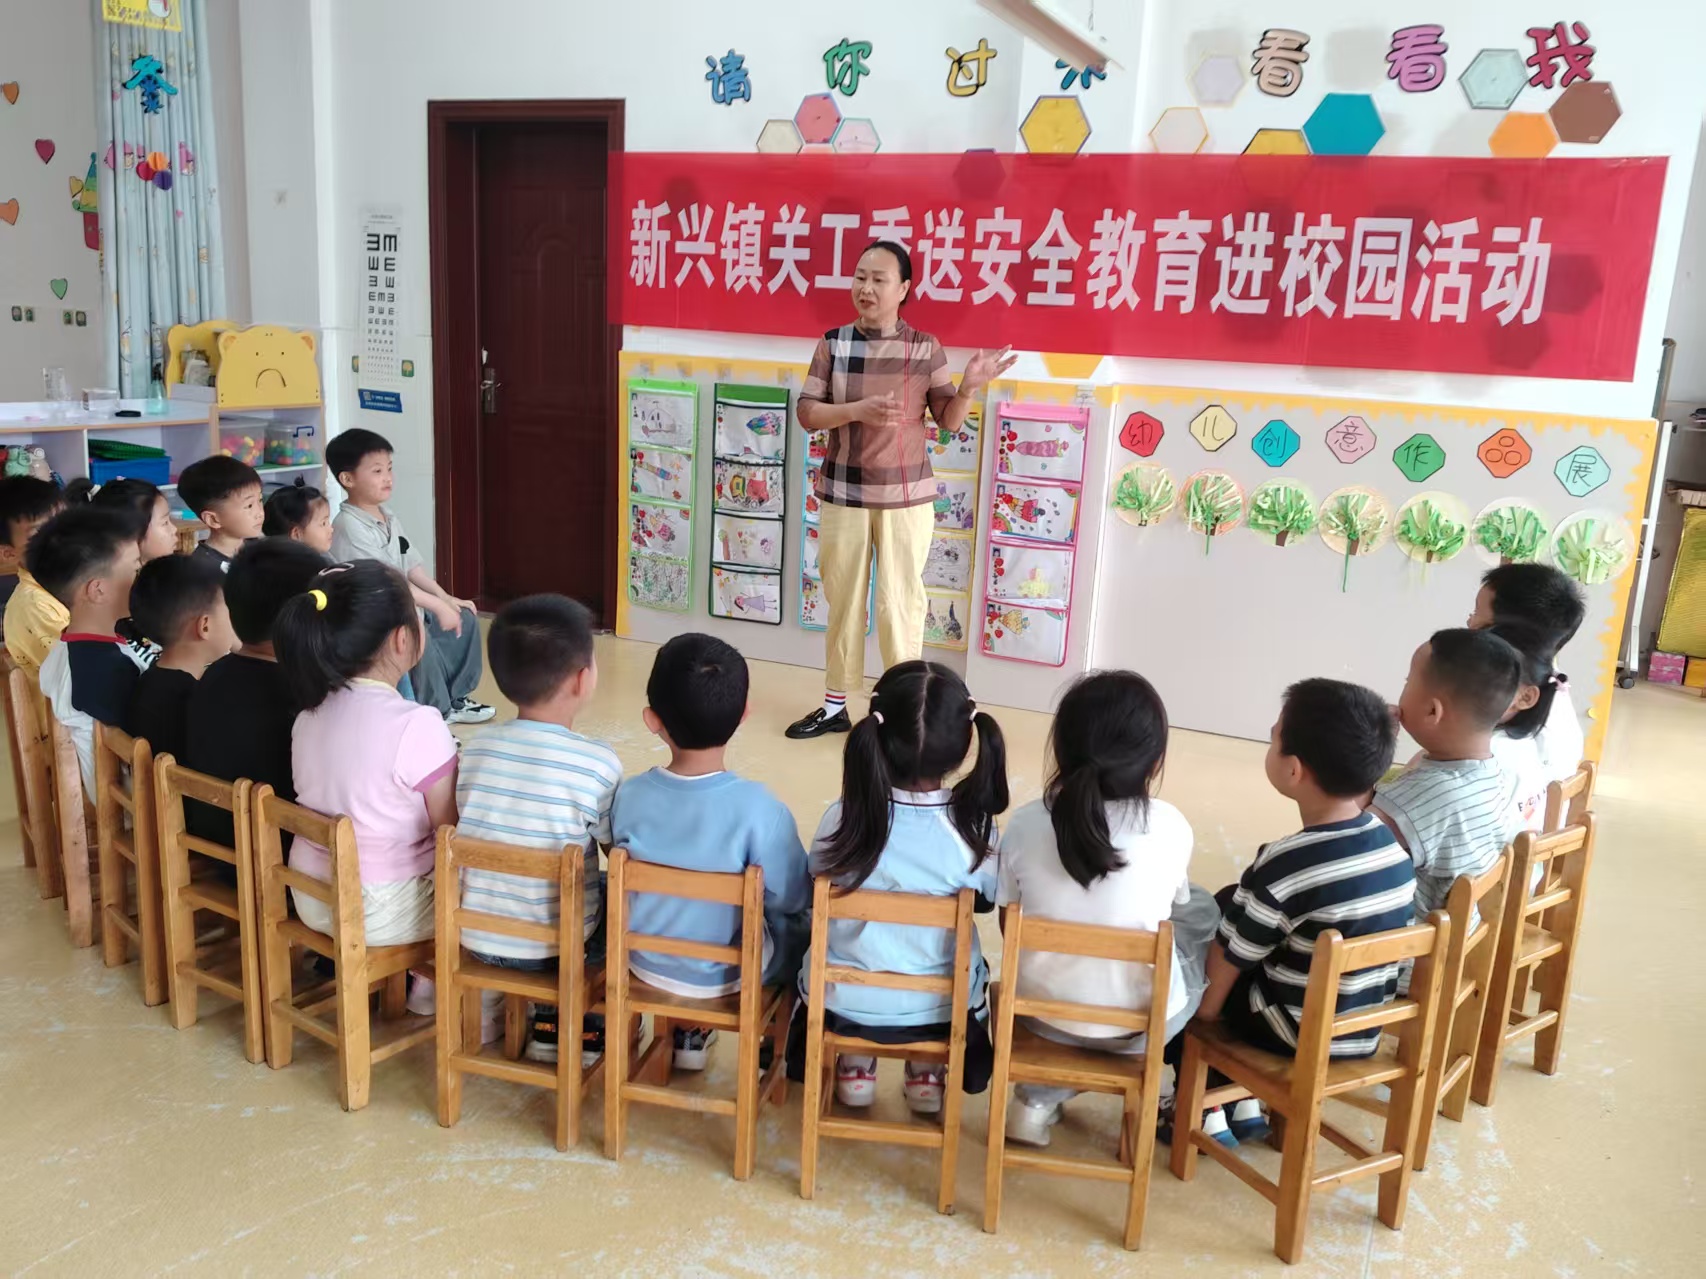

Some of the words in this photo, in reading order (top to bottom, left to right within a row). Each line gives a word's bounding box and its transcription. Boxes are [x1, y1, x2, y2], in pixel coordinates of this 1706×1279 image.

[1129, 414, 1598, 488] 幼儿创意作品展
